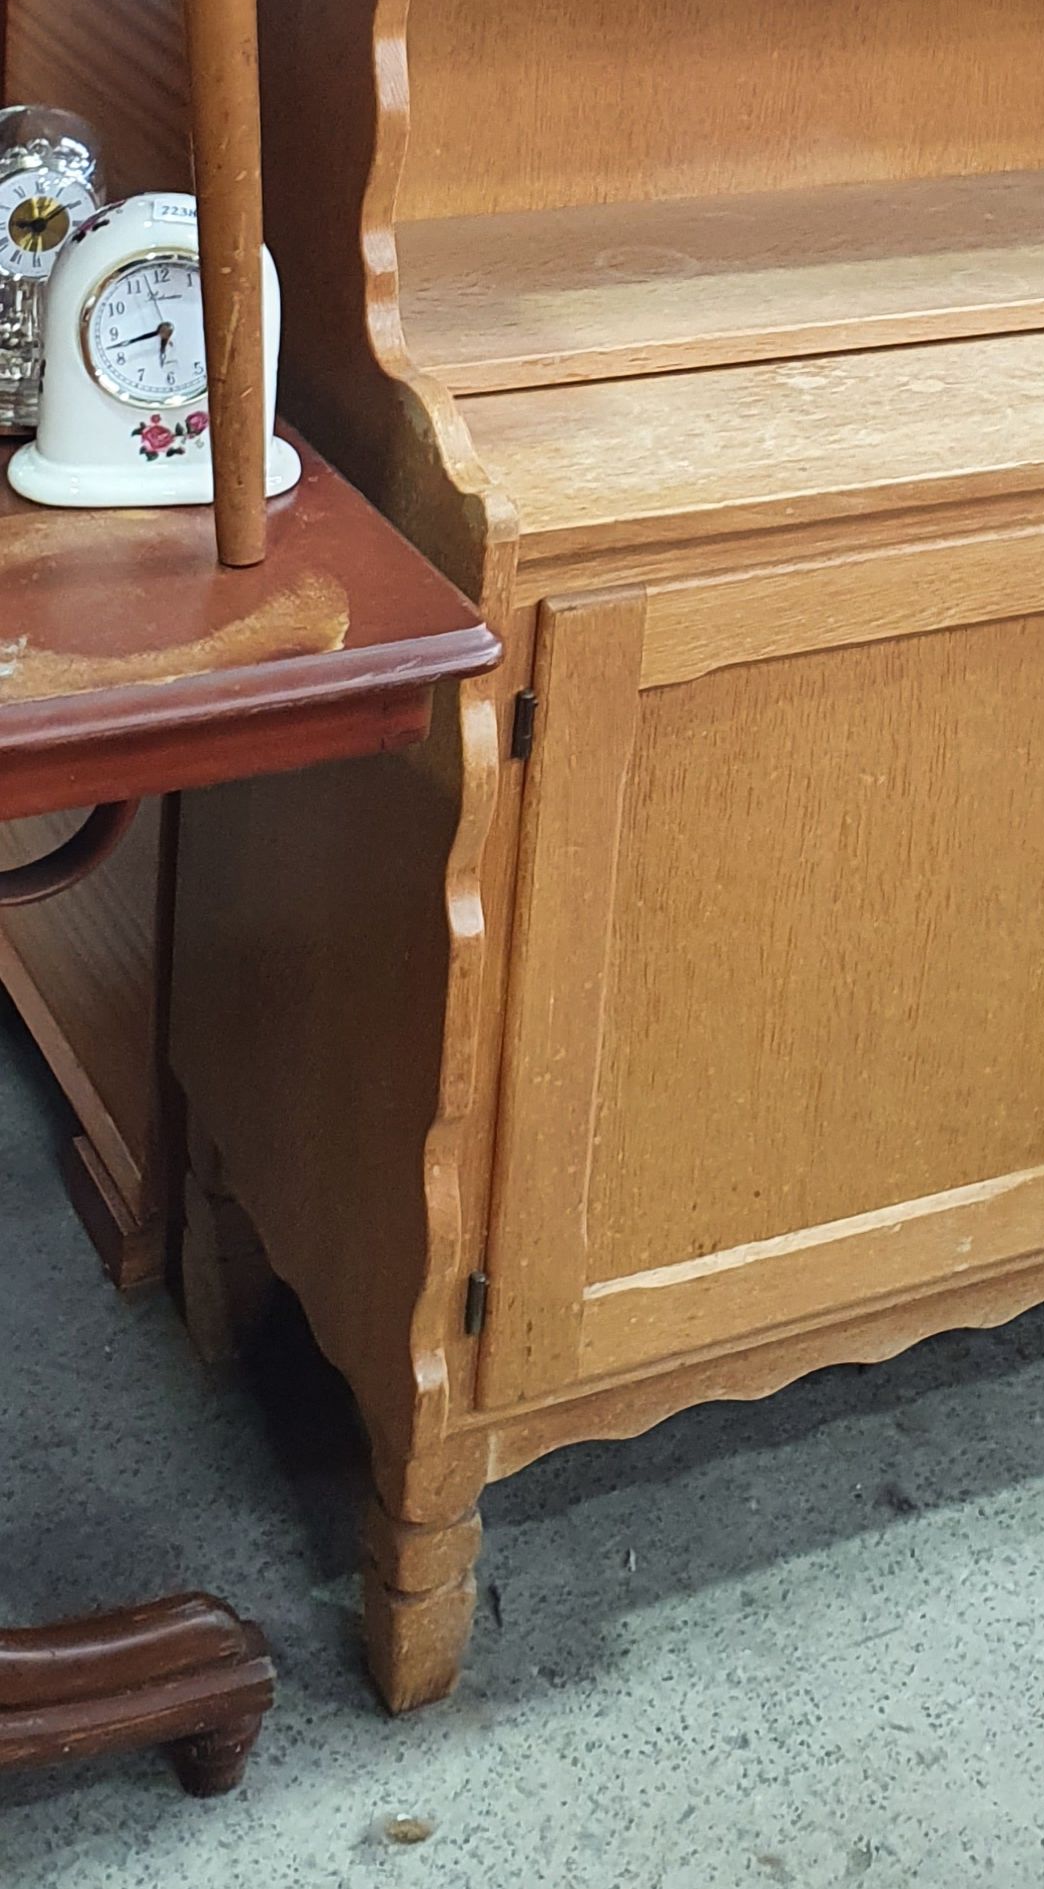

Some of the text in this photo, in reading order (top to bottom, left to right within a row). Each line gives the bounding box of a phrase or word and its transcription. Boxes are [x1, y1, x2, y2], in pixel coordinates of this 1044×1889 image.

[154, 268, 170, 284] 12
[187, 273, 193, 288] 1
[127, 279, 142, 294] 11
[108, 301, 126, 317] 10
[109, 327, 119, 341] 9
[116, 352, 126, 365] 8
[137, 368, 145, 382] 7
[193, 361, 204, 375] 5
[166, 372, 175, 385] 6
